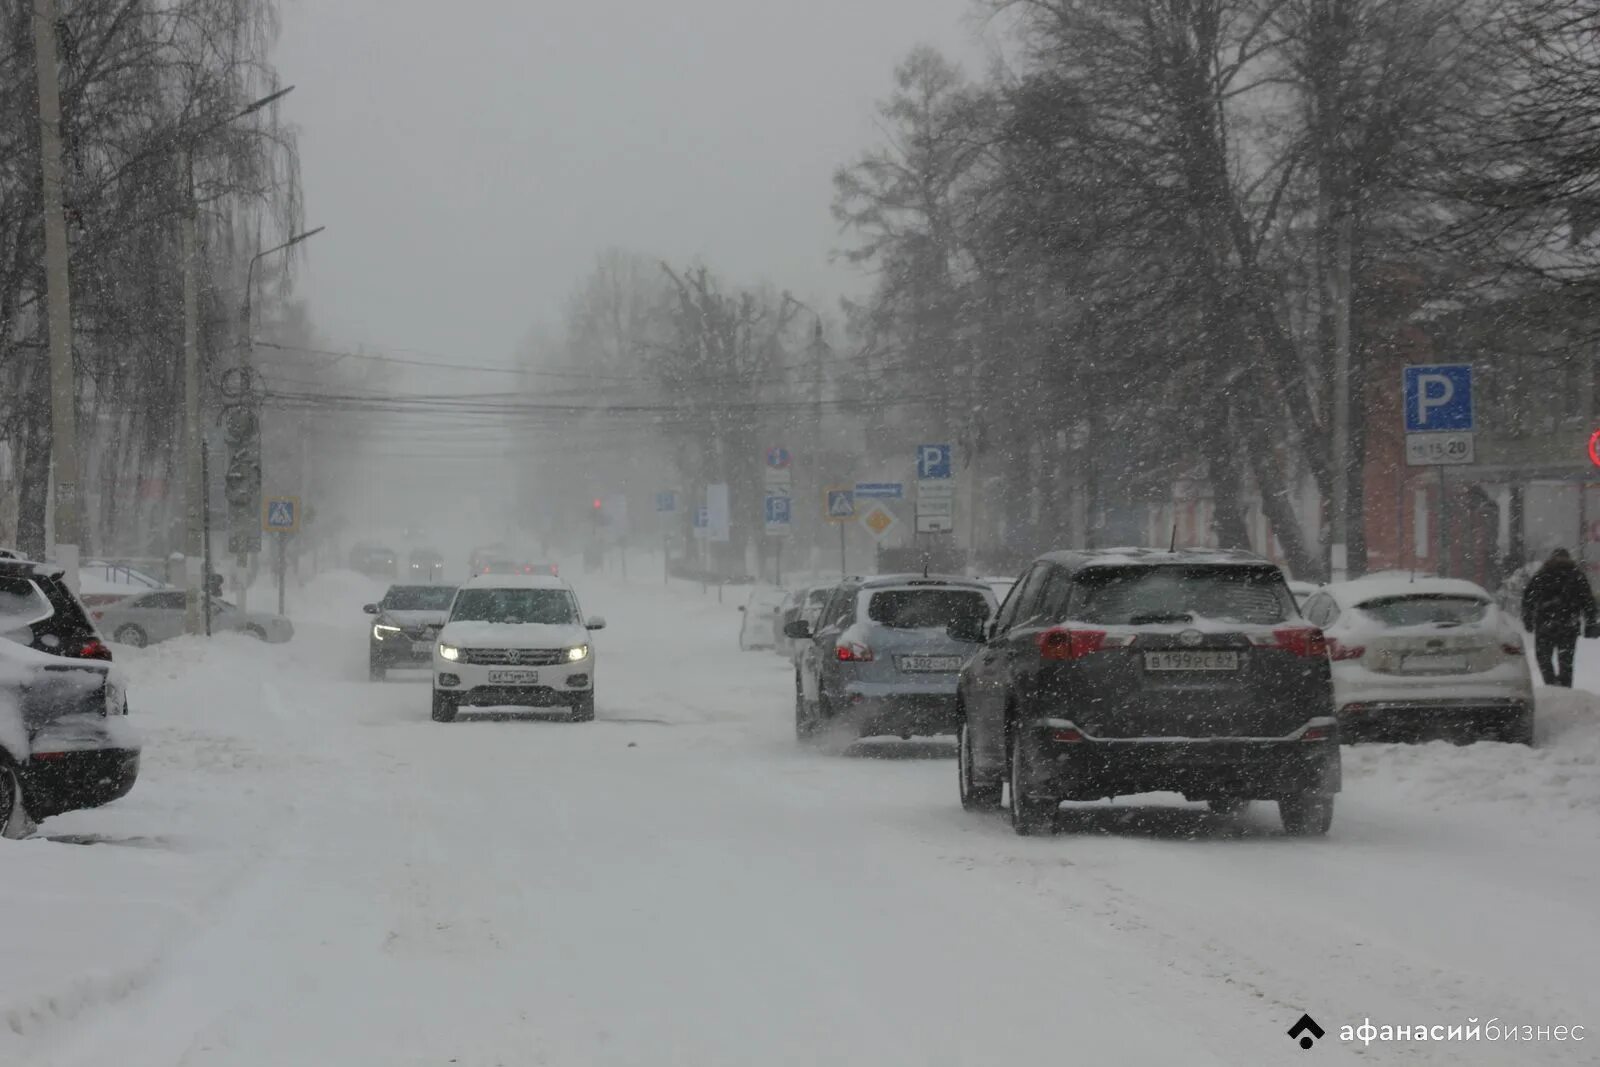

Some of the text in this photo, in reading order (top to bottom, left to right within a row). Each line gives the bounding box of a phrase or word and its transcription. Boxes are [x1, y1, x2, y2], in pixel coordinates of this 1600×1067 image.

[1417, 374, 1455, 425] P
[923, 447, 942, 476] P
[1447, 442, 1467, 454] 20
